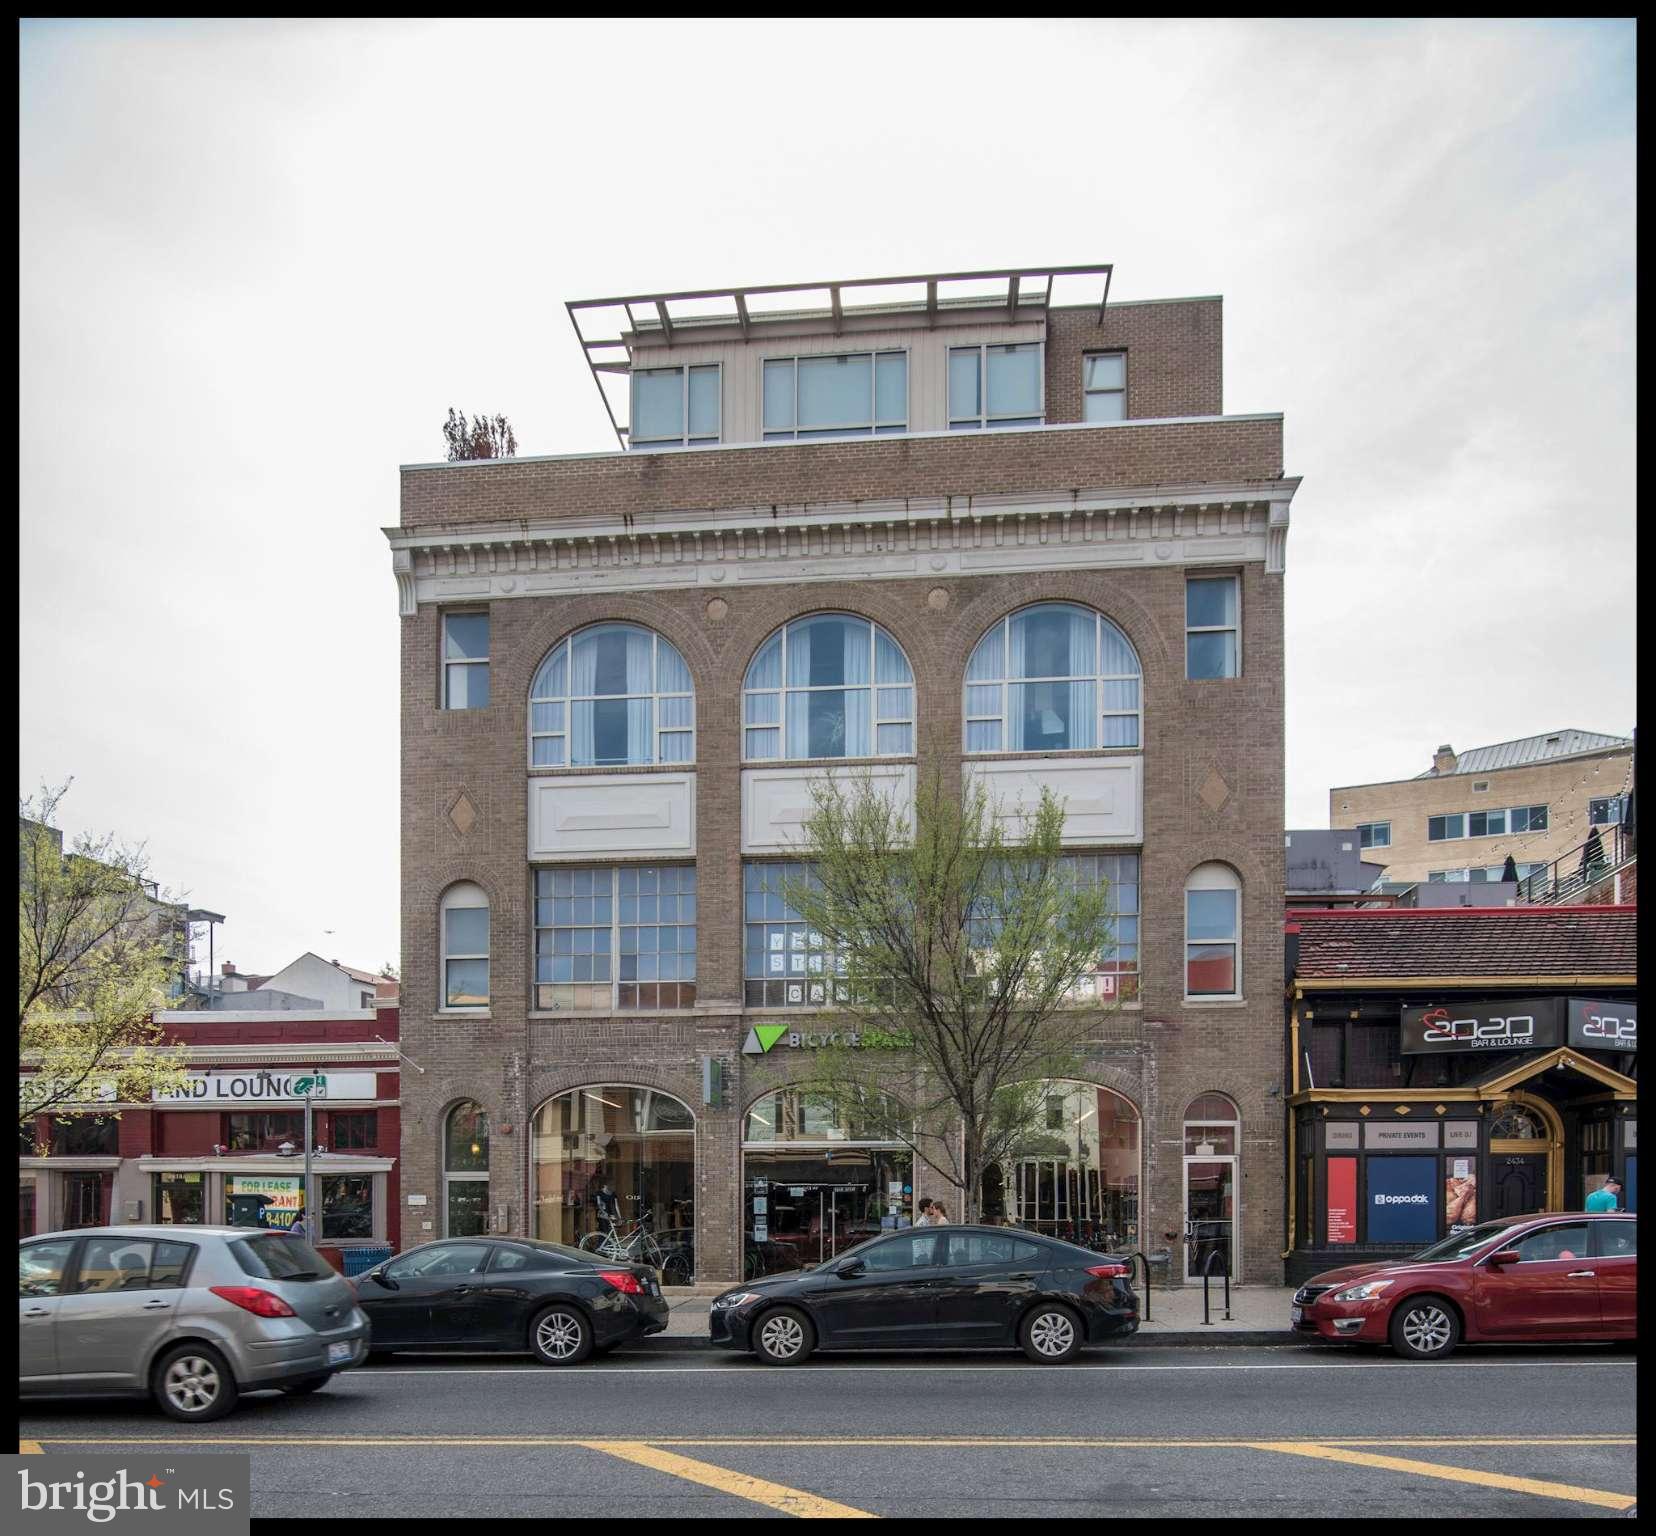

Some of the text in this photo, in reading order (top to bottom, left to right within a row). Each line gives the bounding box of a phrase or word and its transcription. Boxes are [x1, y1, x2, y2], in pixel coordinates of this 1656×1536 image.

[1423, 1015, 1534, 1042] 2020
[1471, 1036, 1533, 1048] BAR & LOUNGE
[159, 1079, 207, 1098] ND
[241, 1180, 292, 1192] FOR LEASE
[1385, 1194, 1429, 1205] oppadak
